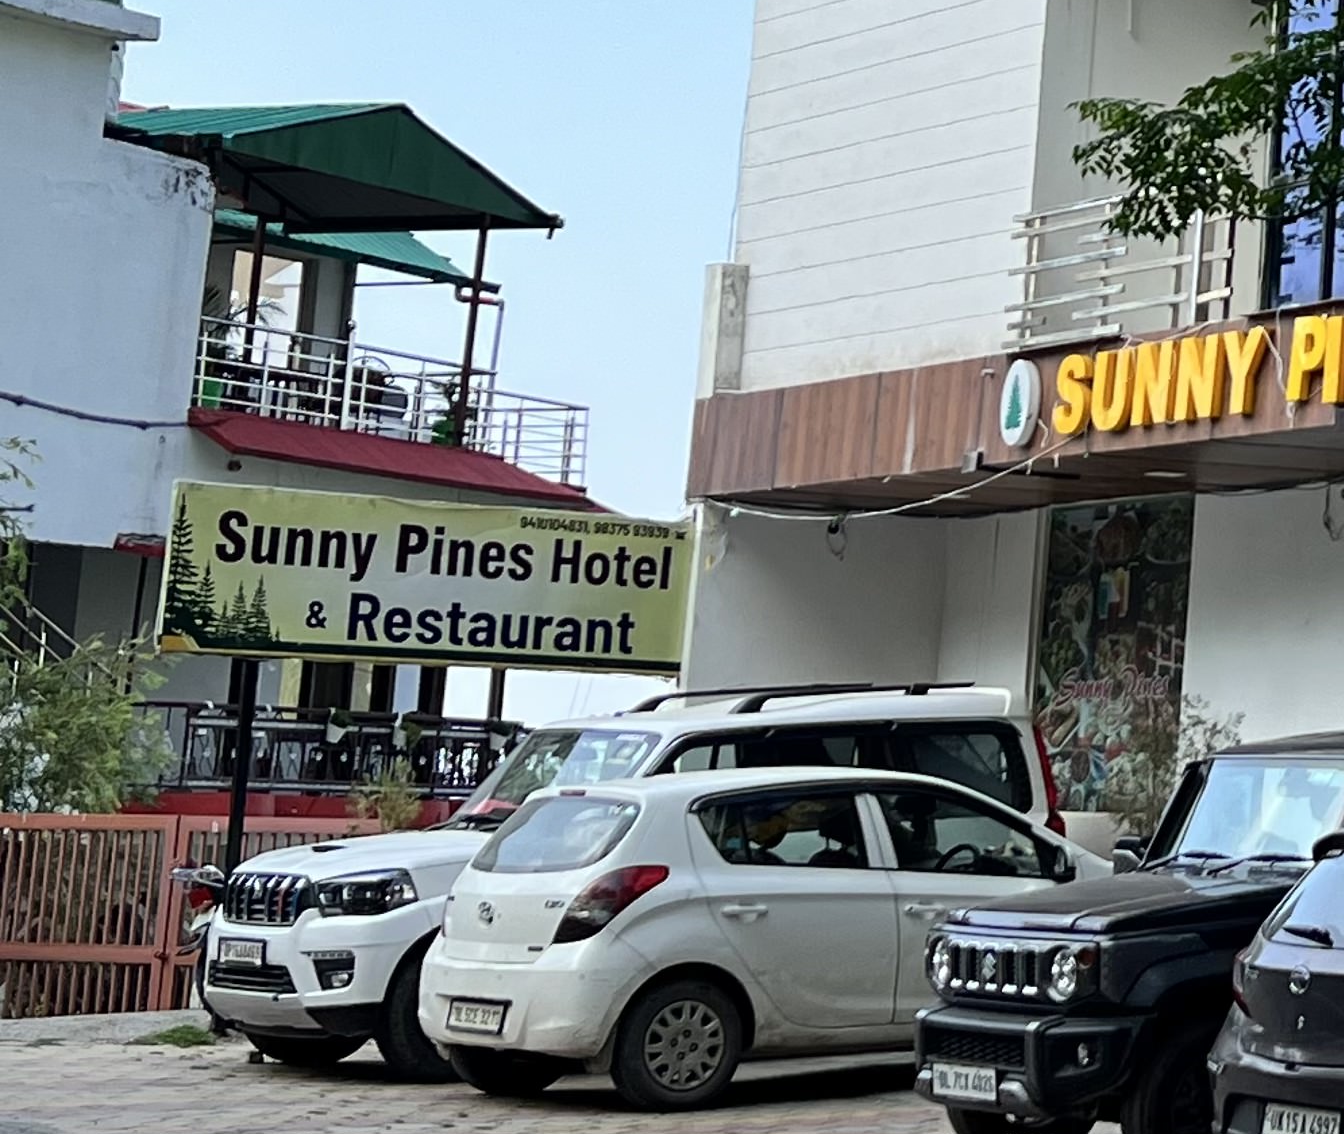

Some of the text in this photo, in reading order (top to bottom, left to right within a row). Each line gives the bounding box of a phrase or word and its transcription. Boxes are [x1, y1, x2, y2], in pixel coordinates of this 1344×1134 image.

[1052, 326, 1269, 436] SUNNY
[214, 509, 673, 590] Sunny Pines Hotel
[305, 592, 635, 655] & Restaurant
